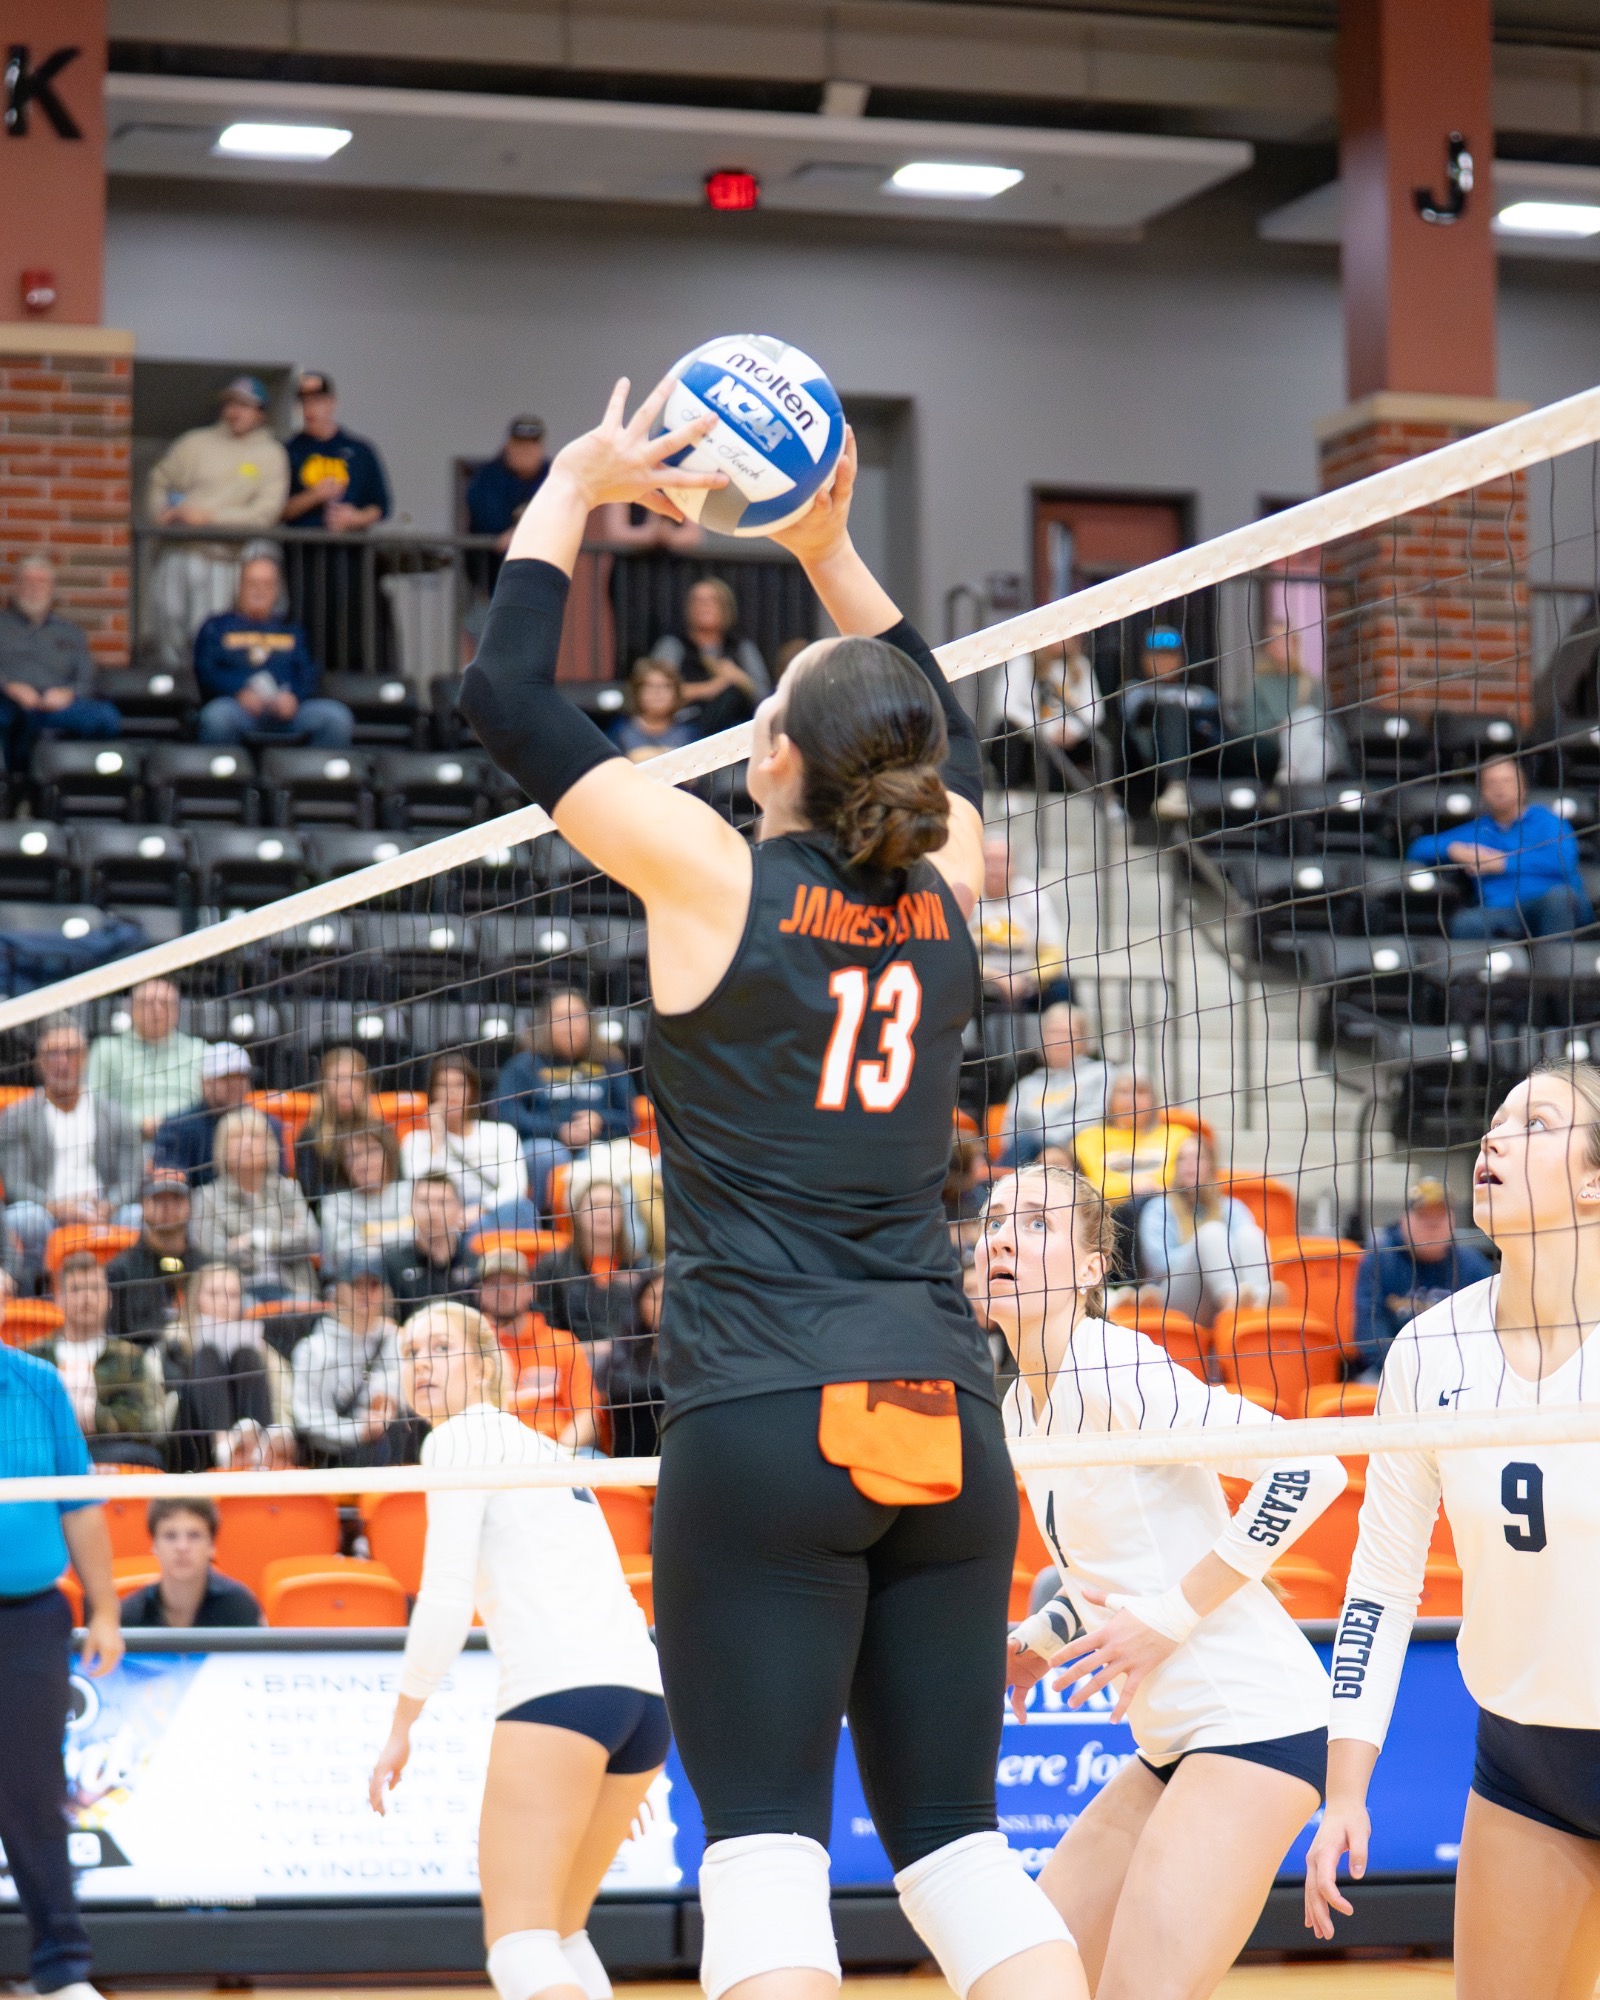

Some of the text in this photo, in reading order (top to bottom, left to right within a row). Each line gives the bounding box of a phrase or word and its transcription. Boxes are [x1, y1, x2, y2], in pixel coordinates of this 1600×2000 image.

[5, 44, 83, 139] K
[1412, 131, 1474, 225] J
[703, 375, 788, 452] NCAA
[726, 353, 815, 431] molten
[779, 884, 949, 947] JAMESTOWN
[815, 960, 922, 1113] 13
[1248, 1469, 1311, 1547] BEARS
[1501, 1461, 1547, 1552] 9
[1332, 1597, 1386, 1700] GOLDEN
[263, 1673, 456, 1693] BANNES
[266, 1703, 341, 1724] ART
[269, 1735, 467, 1756] STICKRS
[271, 1764, 438, 1784] CUSTM
[997, 1755, 1067, 1787] ere
[273, 1796, 468, 1815] MAGETS
[279, 1826, 452, 1847] VEHICLE
[282, 1859, 446, 1880] WINDOW
